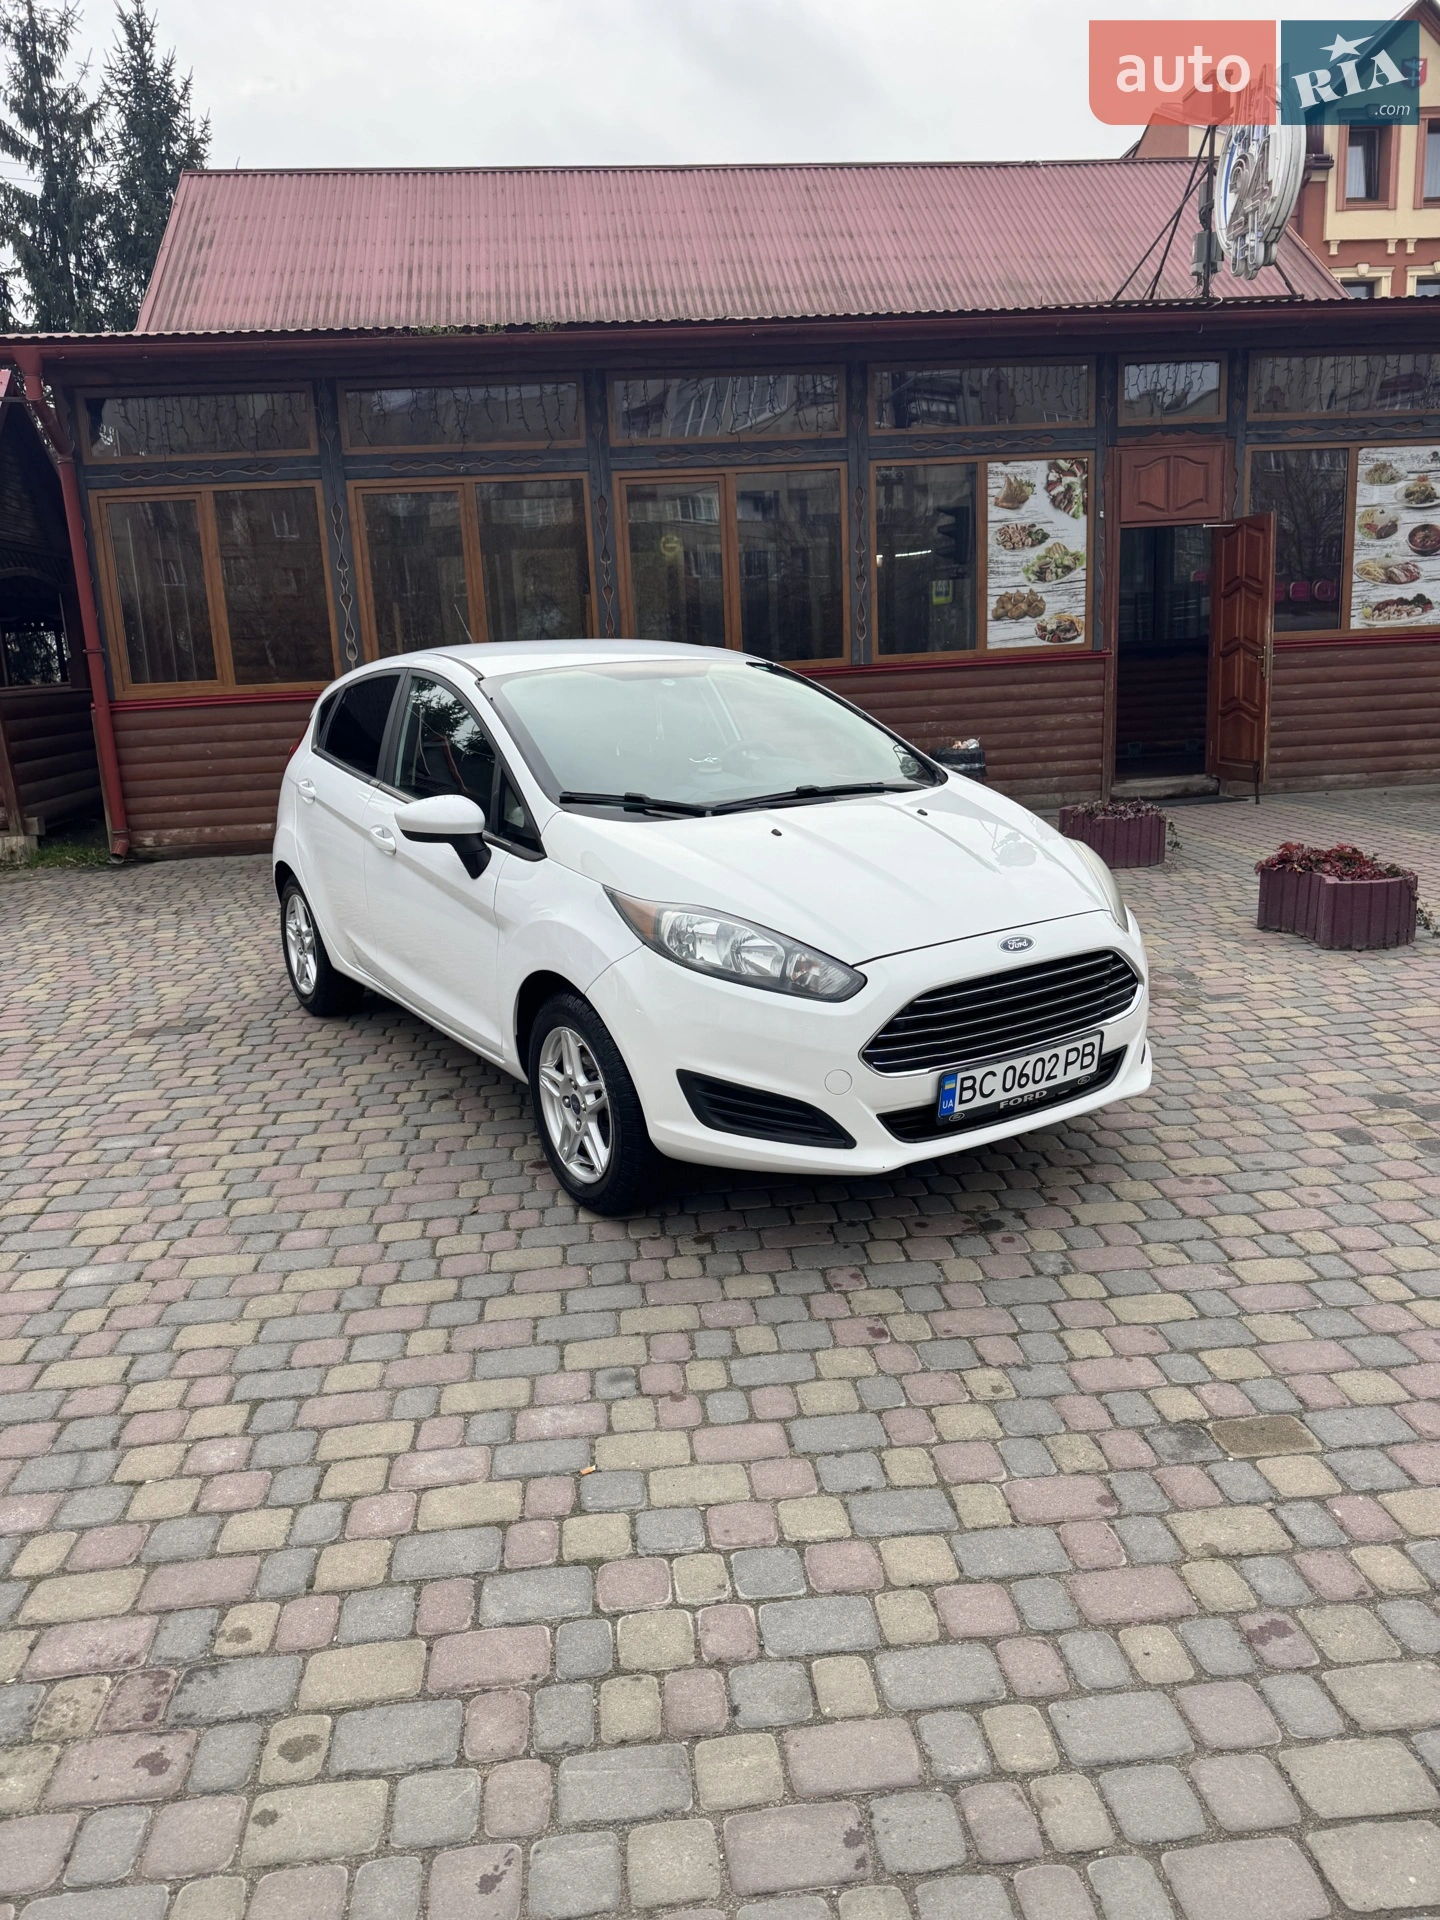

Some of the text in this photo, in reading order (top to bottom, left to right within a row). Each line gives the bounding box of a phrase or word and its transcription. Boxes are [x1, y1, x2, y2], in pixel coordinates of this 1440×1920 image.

[1007, 938, 1029, 950] Ford
[958, 1041, 1096, 1105] BC 0602 PB
[942, 1099, 954, 1110] UA
[999, 1089, 1048, 1109] FORD
